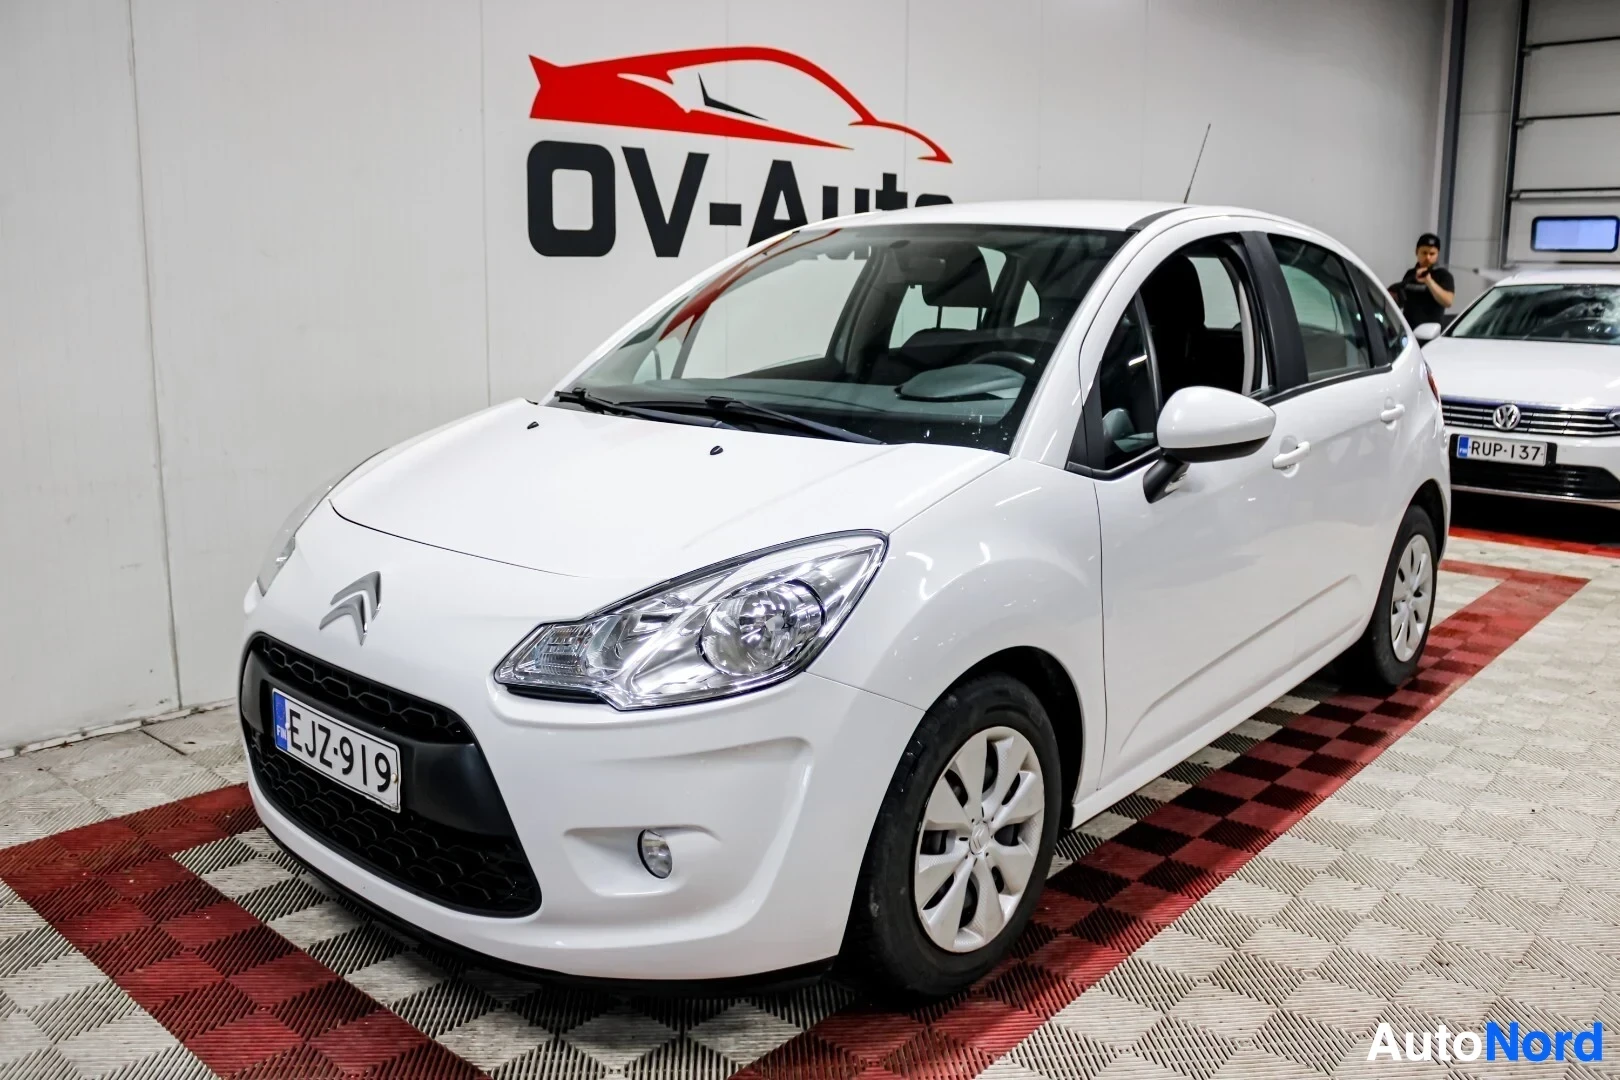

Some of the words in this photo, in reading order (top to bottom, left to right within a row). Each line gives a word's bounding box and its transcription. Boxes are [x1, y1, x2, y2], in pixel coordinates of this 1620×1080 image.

[527, 140, 954, 258] OV-Aut
[1470, 440, 1542, 461] RUP-137
[289, 708, 392, 793] EJZ-919
